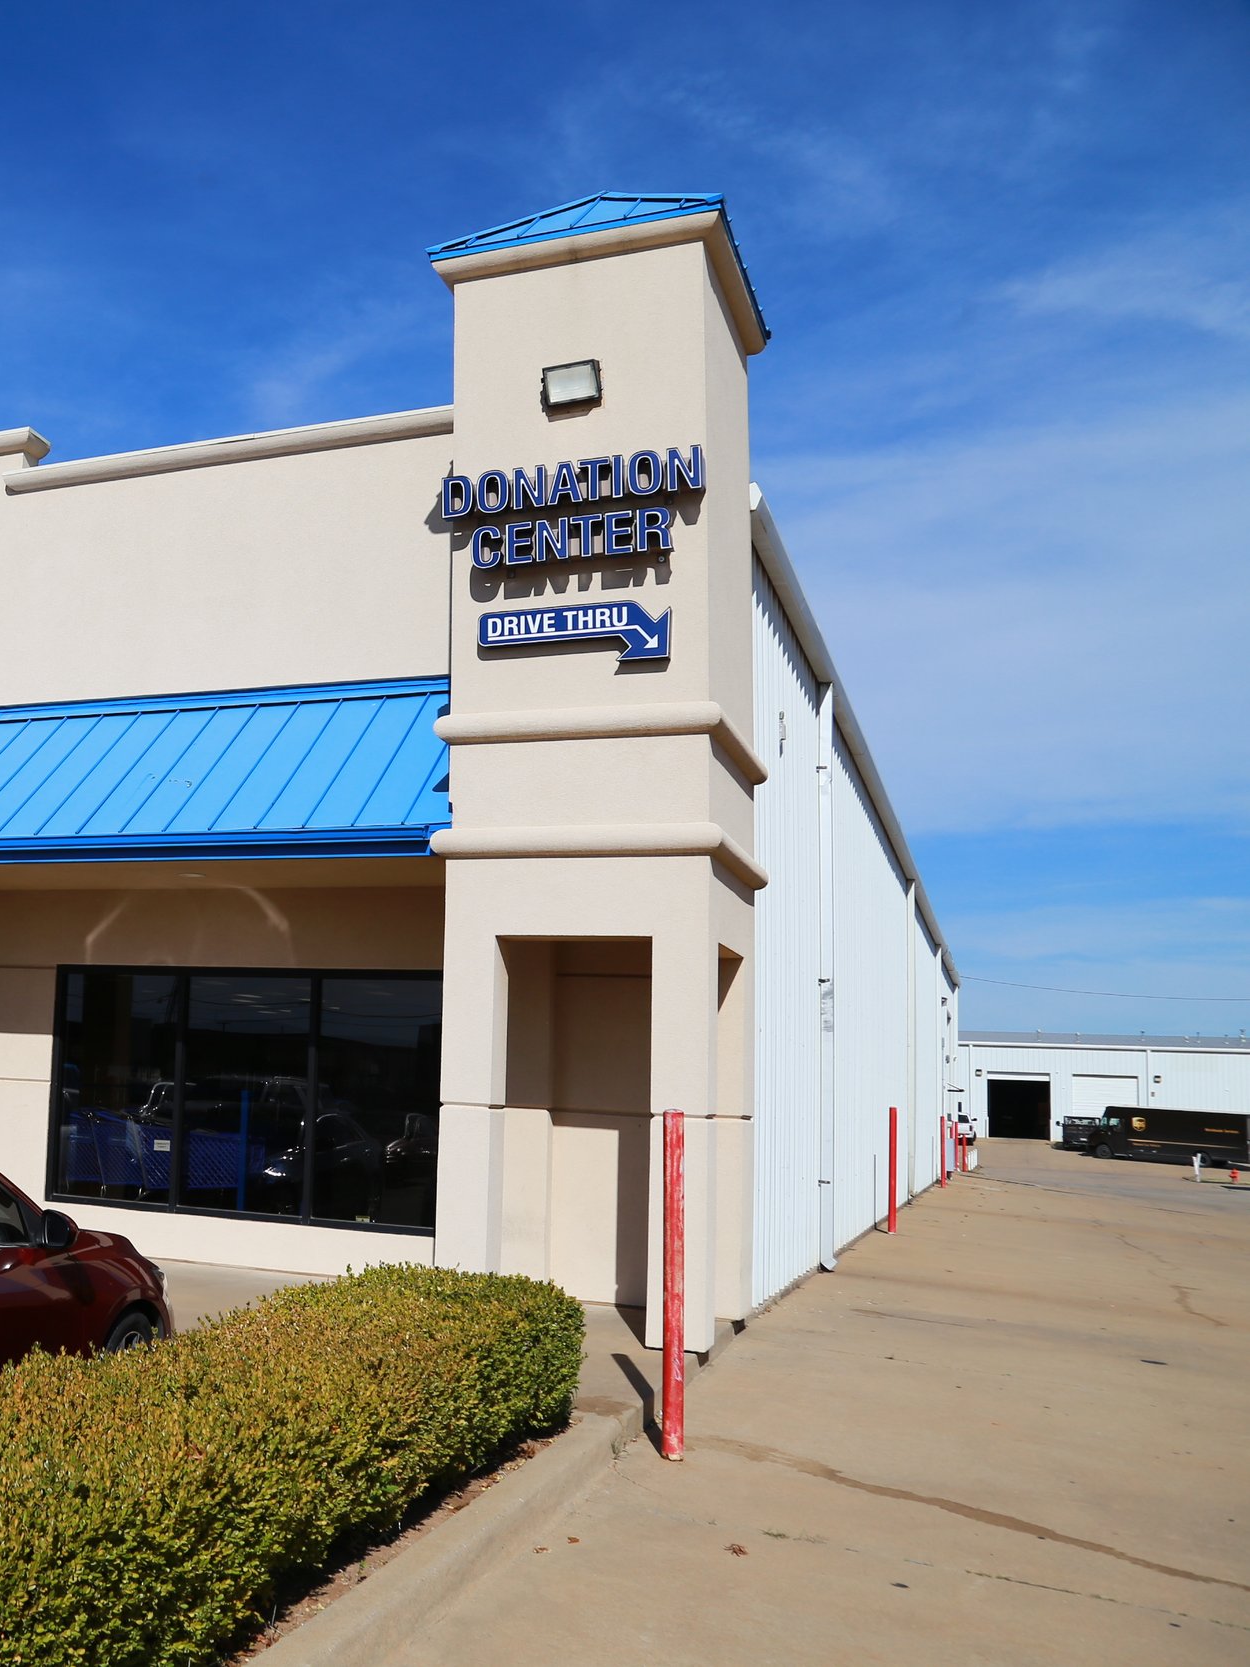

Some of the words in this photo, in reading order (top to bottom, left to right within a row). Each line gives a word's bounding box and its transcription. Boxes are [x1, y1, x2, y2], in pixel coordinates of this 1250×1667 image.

[441, 444, 705, 519] DONATION
[471, 507, 673, 569] CENTER
[487, 612, 556, 637] DRIVE
[563, 606, 628, 630] THRU
